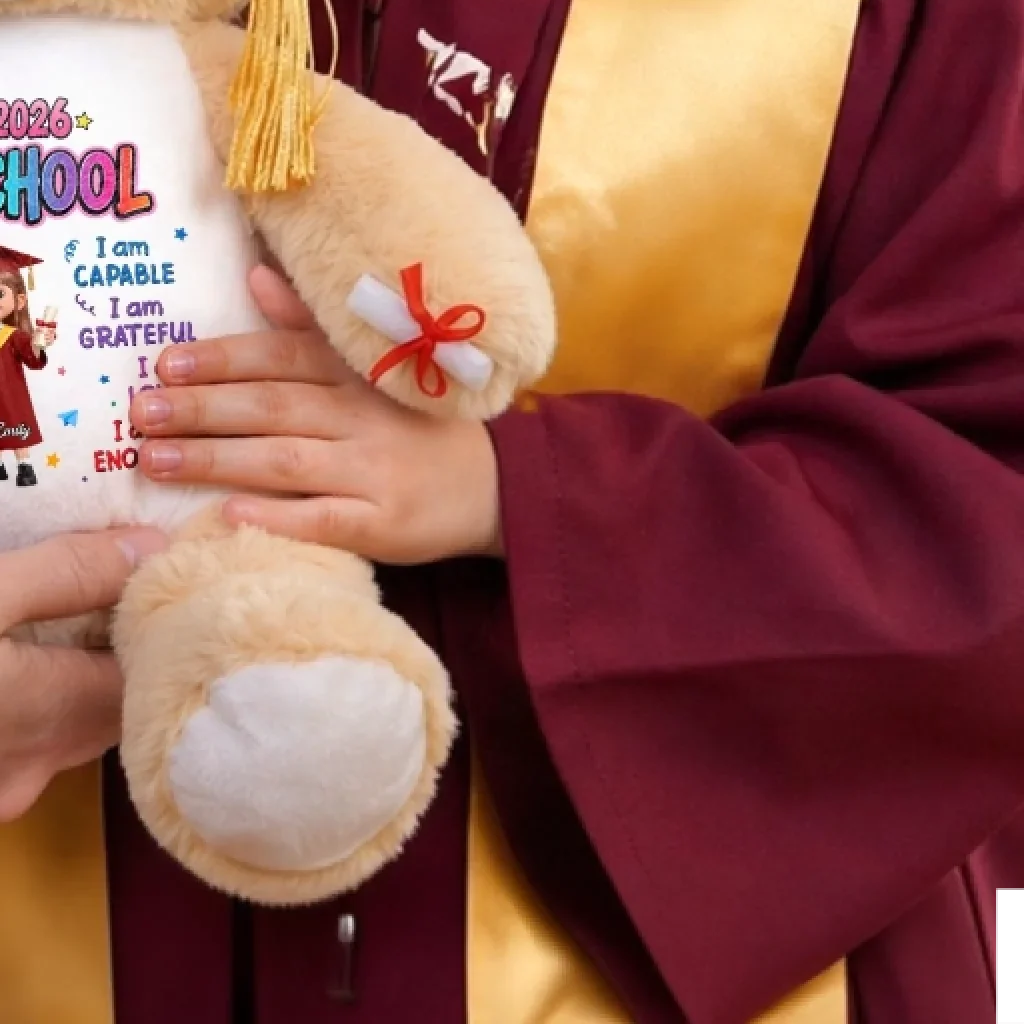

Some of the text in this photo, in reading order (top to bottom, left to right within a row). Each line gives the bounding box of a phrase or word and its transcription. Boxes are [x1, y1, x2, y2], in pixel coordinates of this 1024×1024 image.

[95, 236, 149, 258] I am
[73, 262, 175, 287] CAPABLE
[109, 296, 164, 319] I am
[78, 320, 197, 349] GRATEFUL
[93, 446, 139, 473] ENO
